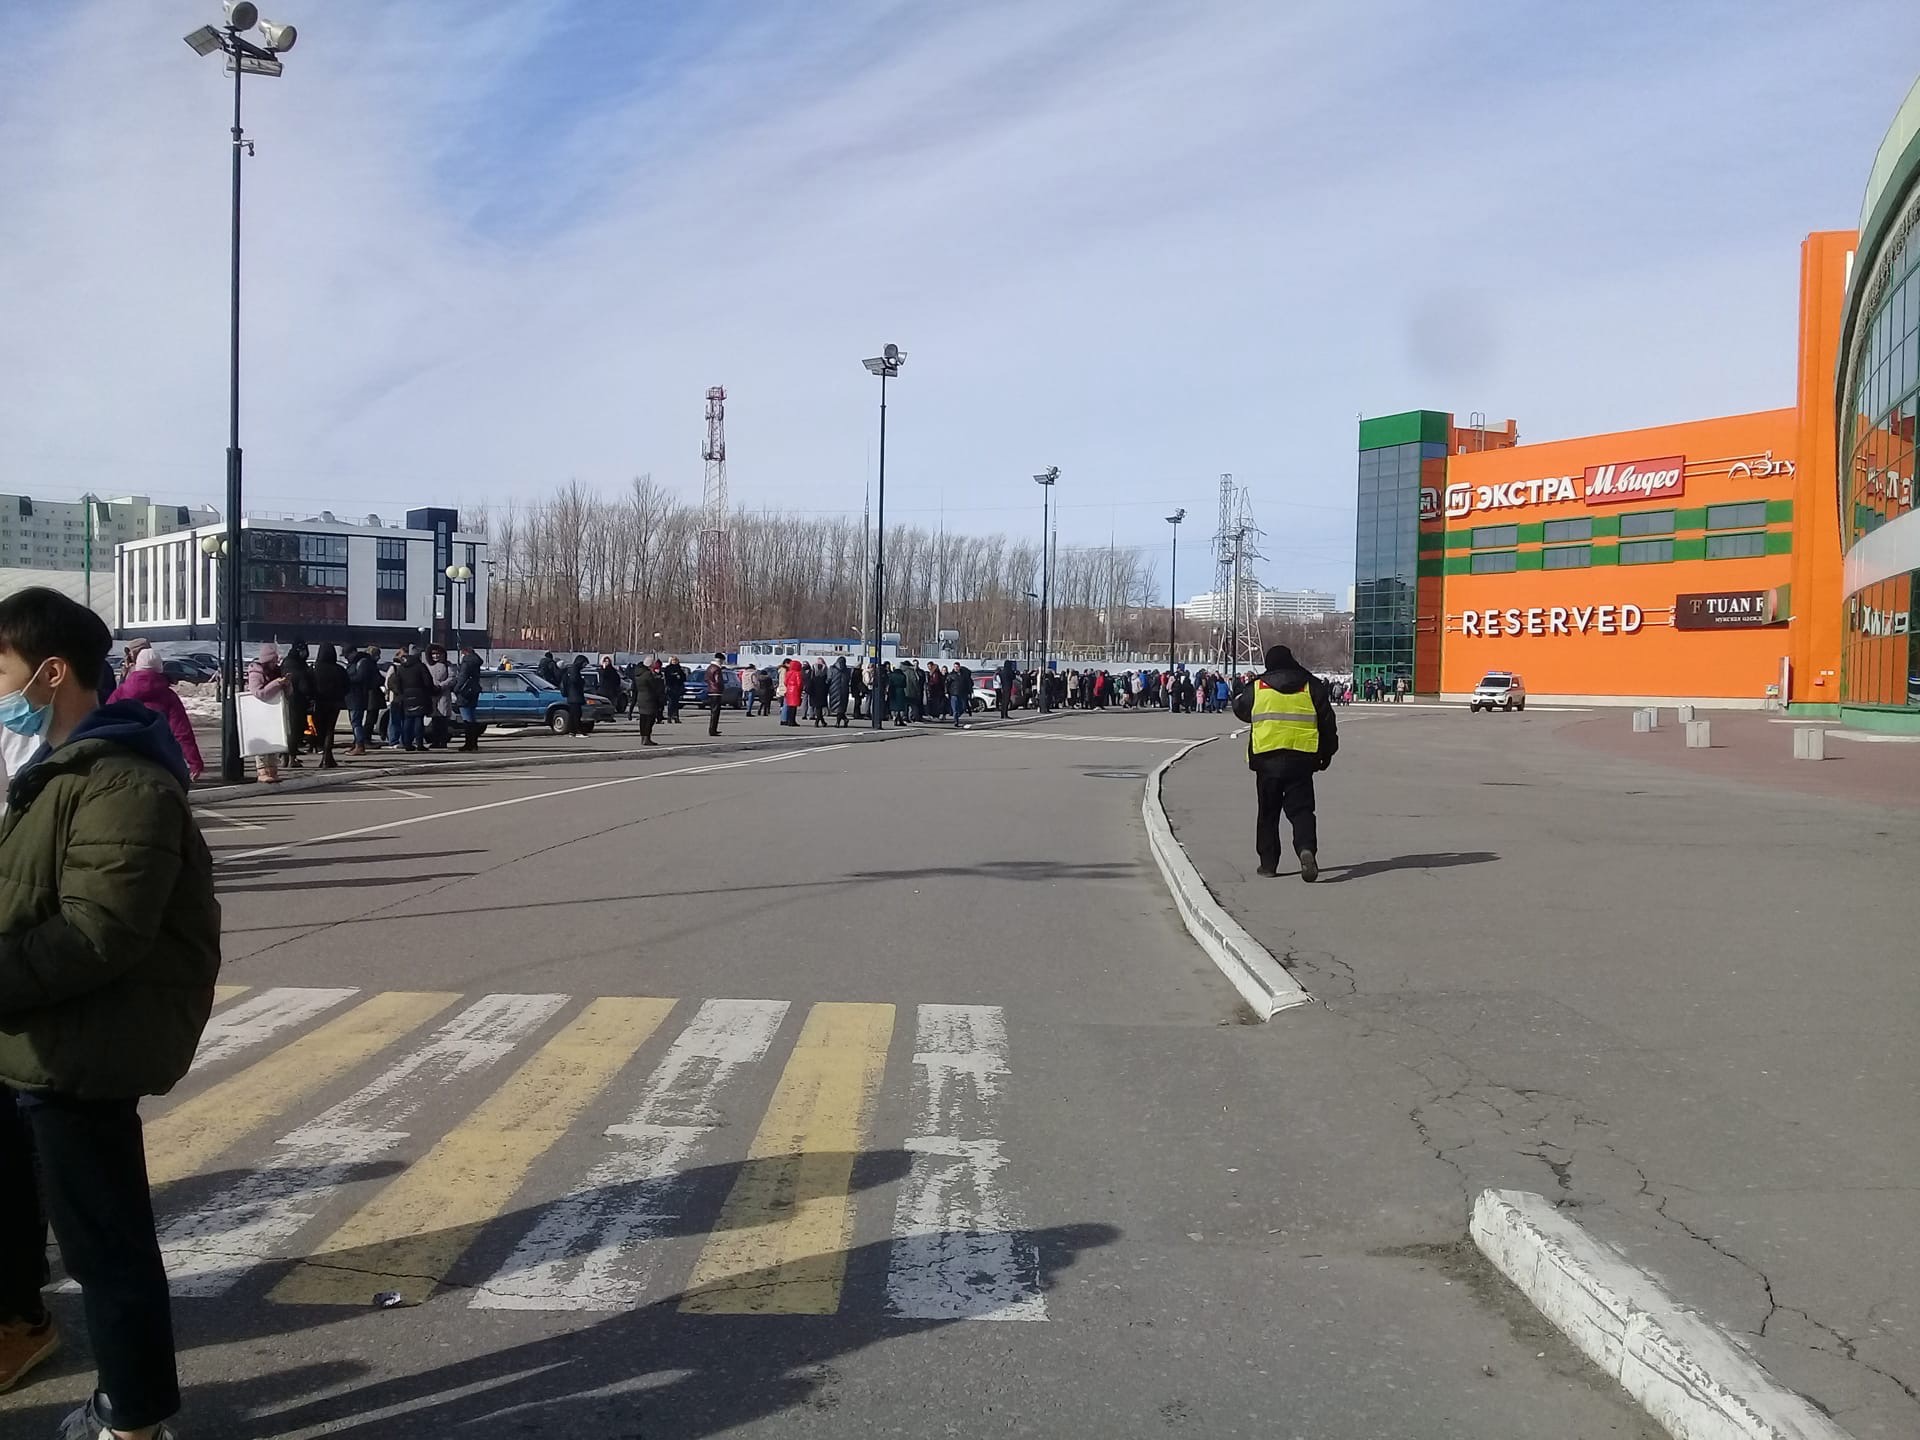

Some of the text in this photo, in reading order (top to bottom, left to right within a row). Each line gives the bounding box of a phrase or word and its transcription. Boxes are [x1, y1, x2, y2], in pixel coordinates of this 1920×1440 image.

[1476, 476, 1577, 509] ЭКСТРА
[1586, 465, 1680, 496] М.видео
[1463, 604, 1641, 634] RESERVED
[1707, 597, 1752, 613] TUAN
